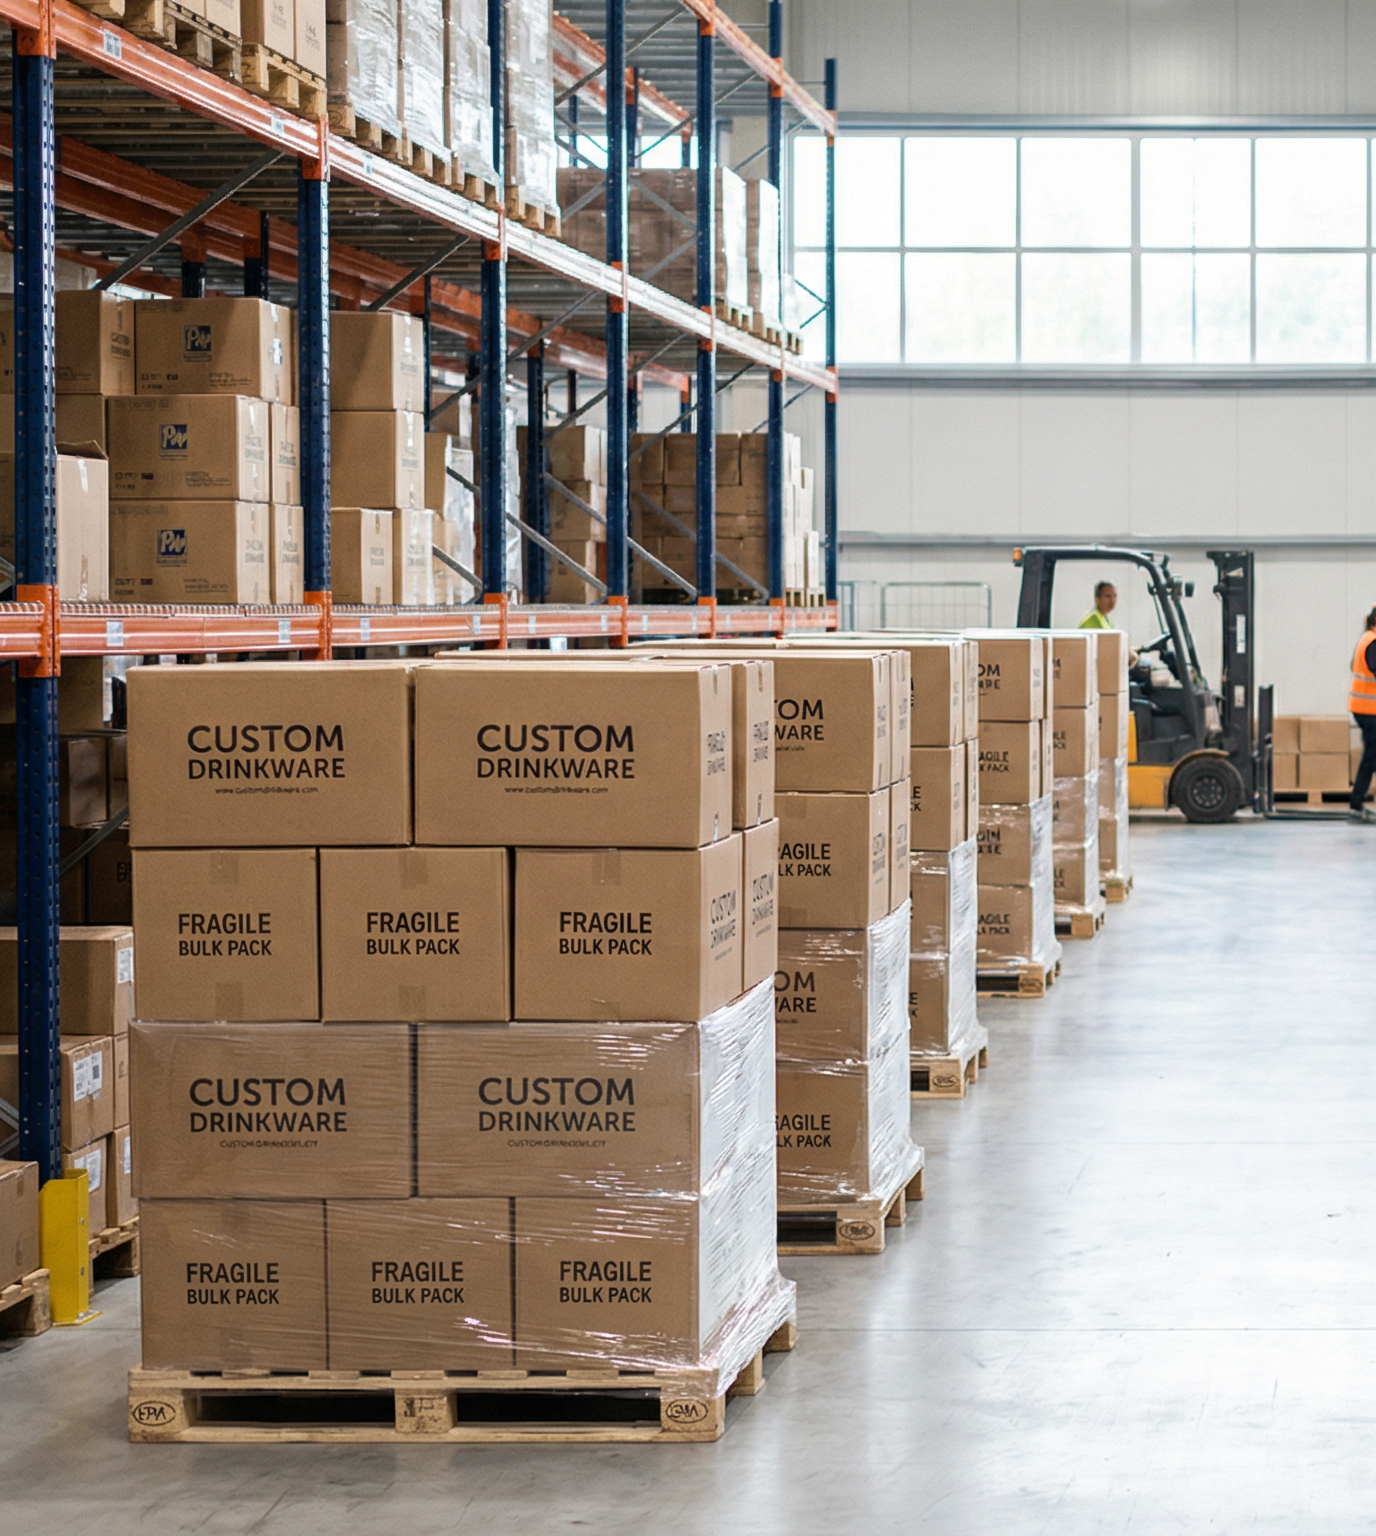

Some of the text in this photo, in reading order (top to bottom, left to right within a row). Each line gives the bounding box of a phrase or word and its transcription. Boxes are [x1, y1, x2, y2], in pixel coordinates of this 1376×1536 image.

[188, 725, 343, 753] CUSTOM
[477, 725, 633, 752] CUSTOM
[189, 758, 345, 779] DRINKWARE
[478, 758, 634, 778] DRINKWARE
[780, 843, 830, 859] AGILE
[798, 864, 831, 876] PACK
[179, 913, 271, 934] FRAGILE
[367, 912, 459, 933] FRAGILE
[560, 912, 652, 933] FRAGILE
[179, 940, 272, 956] BULK PACK
[367, 939, 460, 954] BULK PACK
[560, 938, 651, 955] BULK PACK
[190, 1078, 345, 1106] CUSTOM
[479, 1078, 634, 1105] CUSTOM
[190, 1112, 347, 1132] DRINKWARE
[479, 1111, 635, 1131] DRINKWARE
[797, 1135, 831, 1147] PACK
[187, 1263, 279, 1283] FRAGILE
[372, 1262, 463, 1282] FRAGILE
[560, 1261, 651, 1281] FRAGILE
[187, 1289, 279, 1304] BULK PACK
[372, 1288, 464, 1303] BULK PACK
[560, 1287, 651, 1303] BULK PACK
